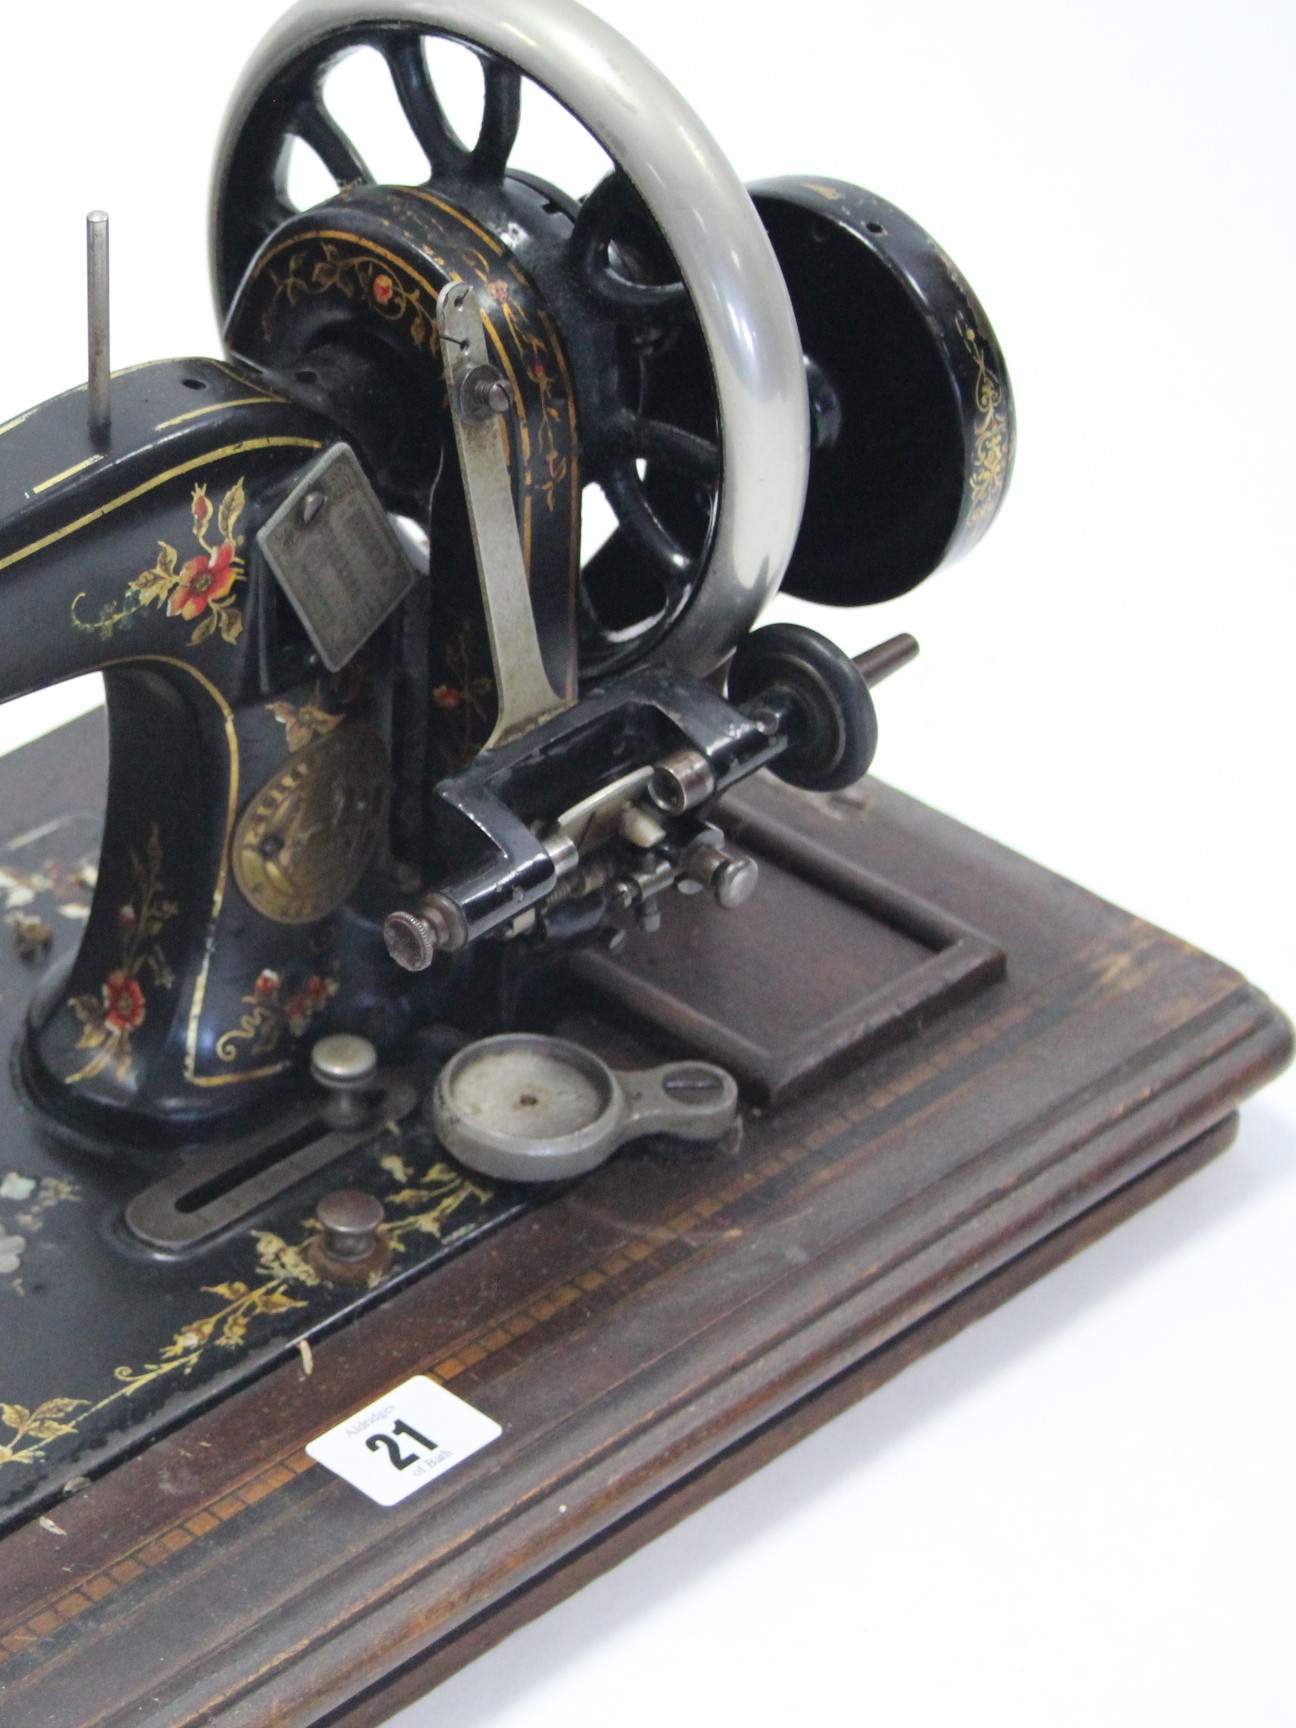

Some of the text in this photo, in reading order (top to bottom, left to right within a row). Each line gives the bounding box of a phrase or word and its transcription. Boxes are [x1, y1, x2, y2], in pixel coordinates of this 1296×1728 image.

[365, 1418, 440, 1472] 21
[412, 1447, 454, 1479] of Bath
